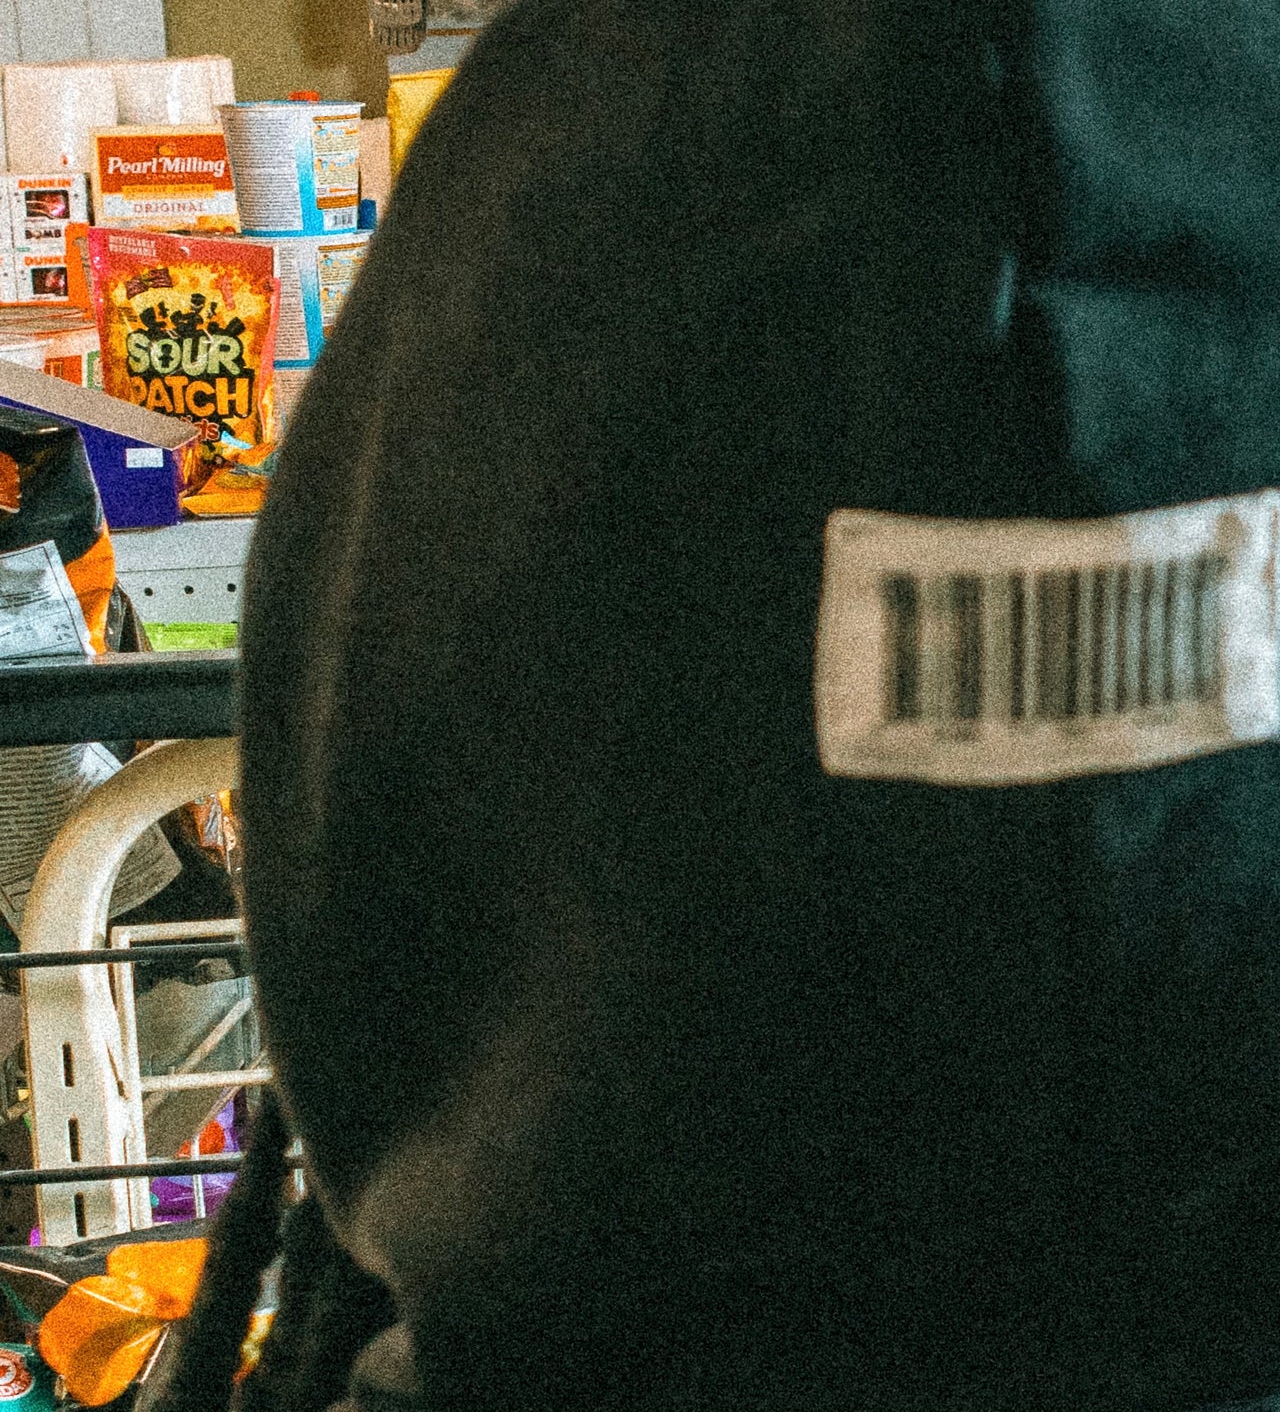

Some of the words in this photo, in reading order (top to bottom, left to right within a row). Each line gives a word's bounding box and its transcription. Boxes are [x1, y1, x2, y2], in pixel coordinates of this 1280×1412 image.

[107, 156, 157, 175] Pearl
[158, 156, 226, 178] Milling
[133, 202, 205, 214] ORIGINAL
[127, 331, 242, 377] SOUR
[129, 375, 250, 418] PATCH
